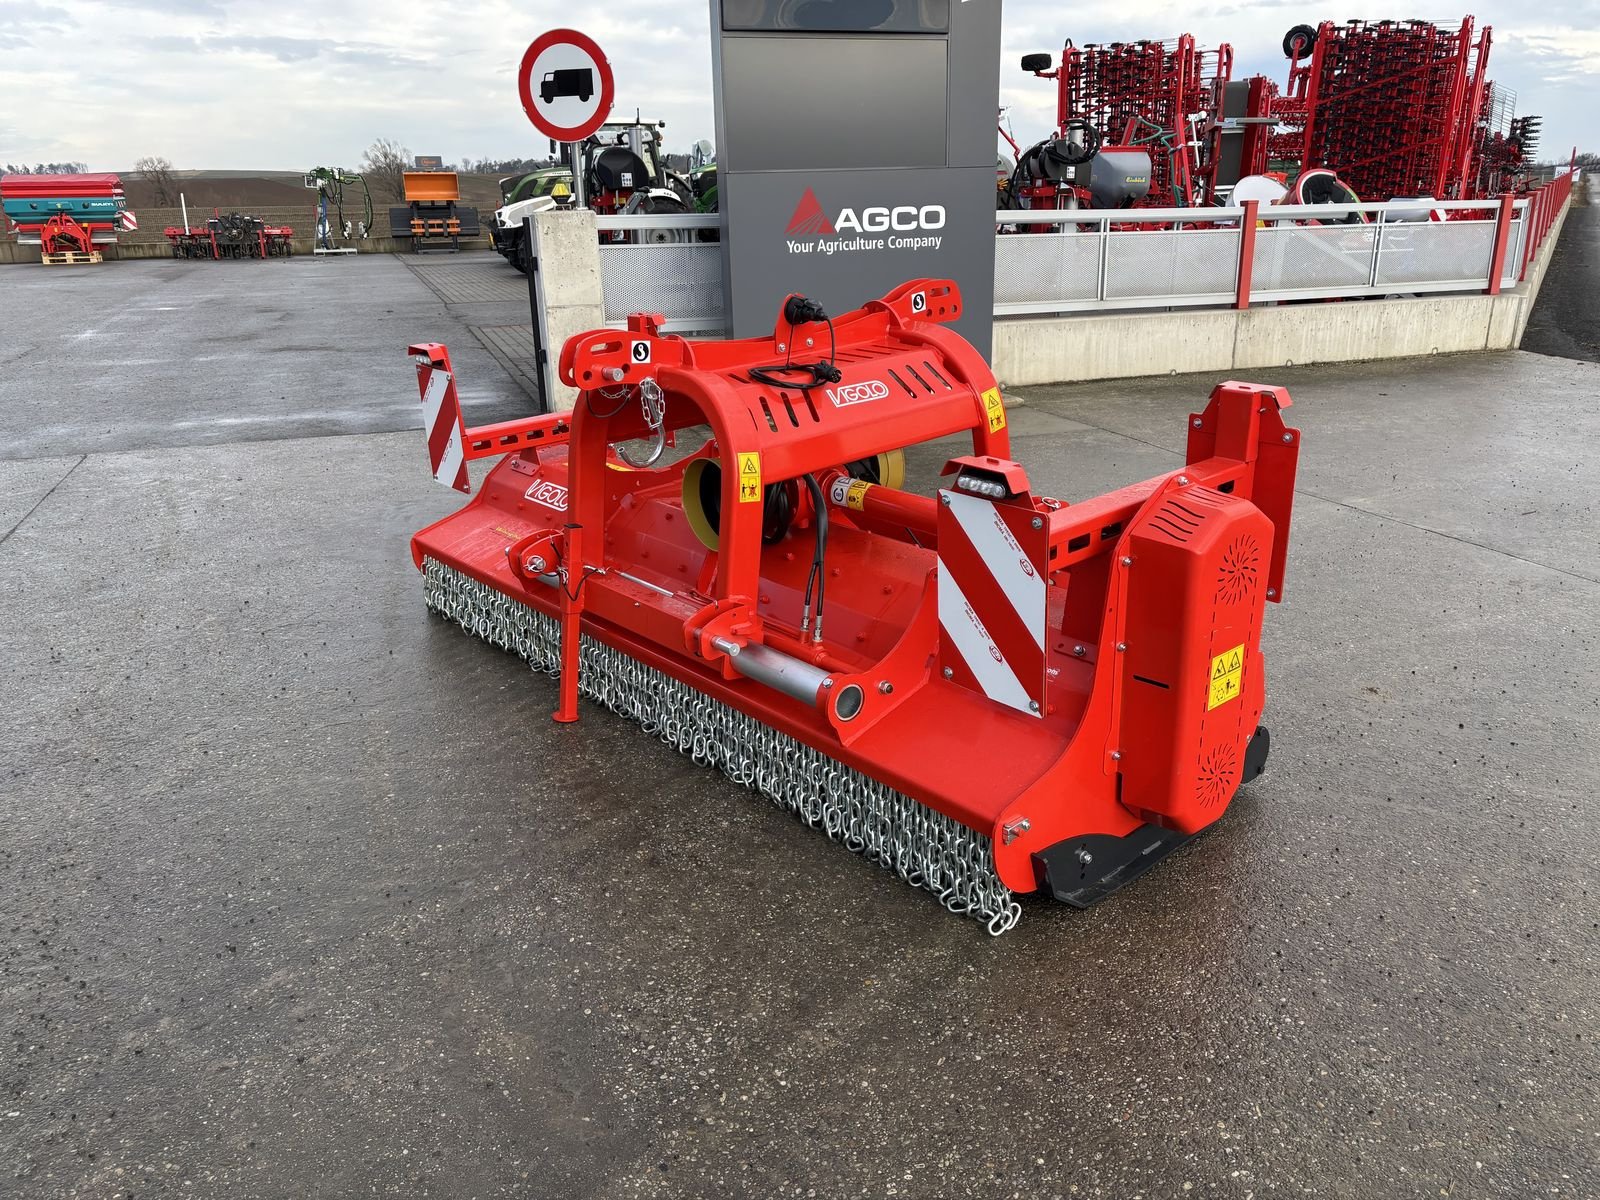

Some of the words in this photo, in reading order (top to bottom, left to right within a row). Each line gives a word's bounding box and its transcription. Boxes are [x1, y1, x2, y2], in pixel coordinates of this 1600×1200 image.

[834, 205, 946, 233] AGCO
[786, 240, 814, 254] Your
[817, 236, 884, 255] Agriculture
[888, 236, 942, 250] Company
[826, 380, 889, 408] VIGOLO
